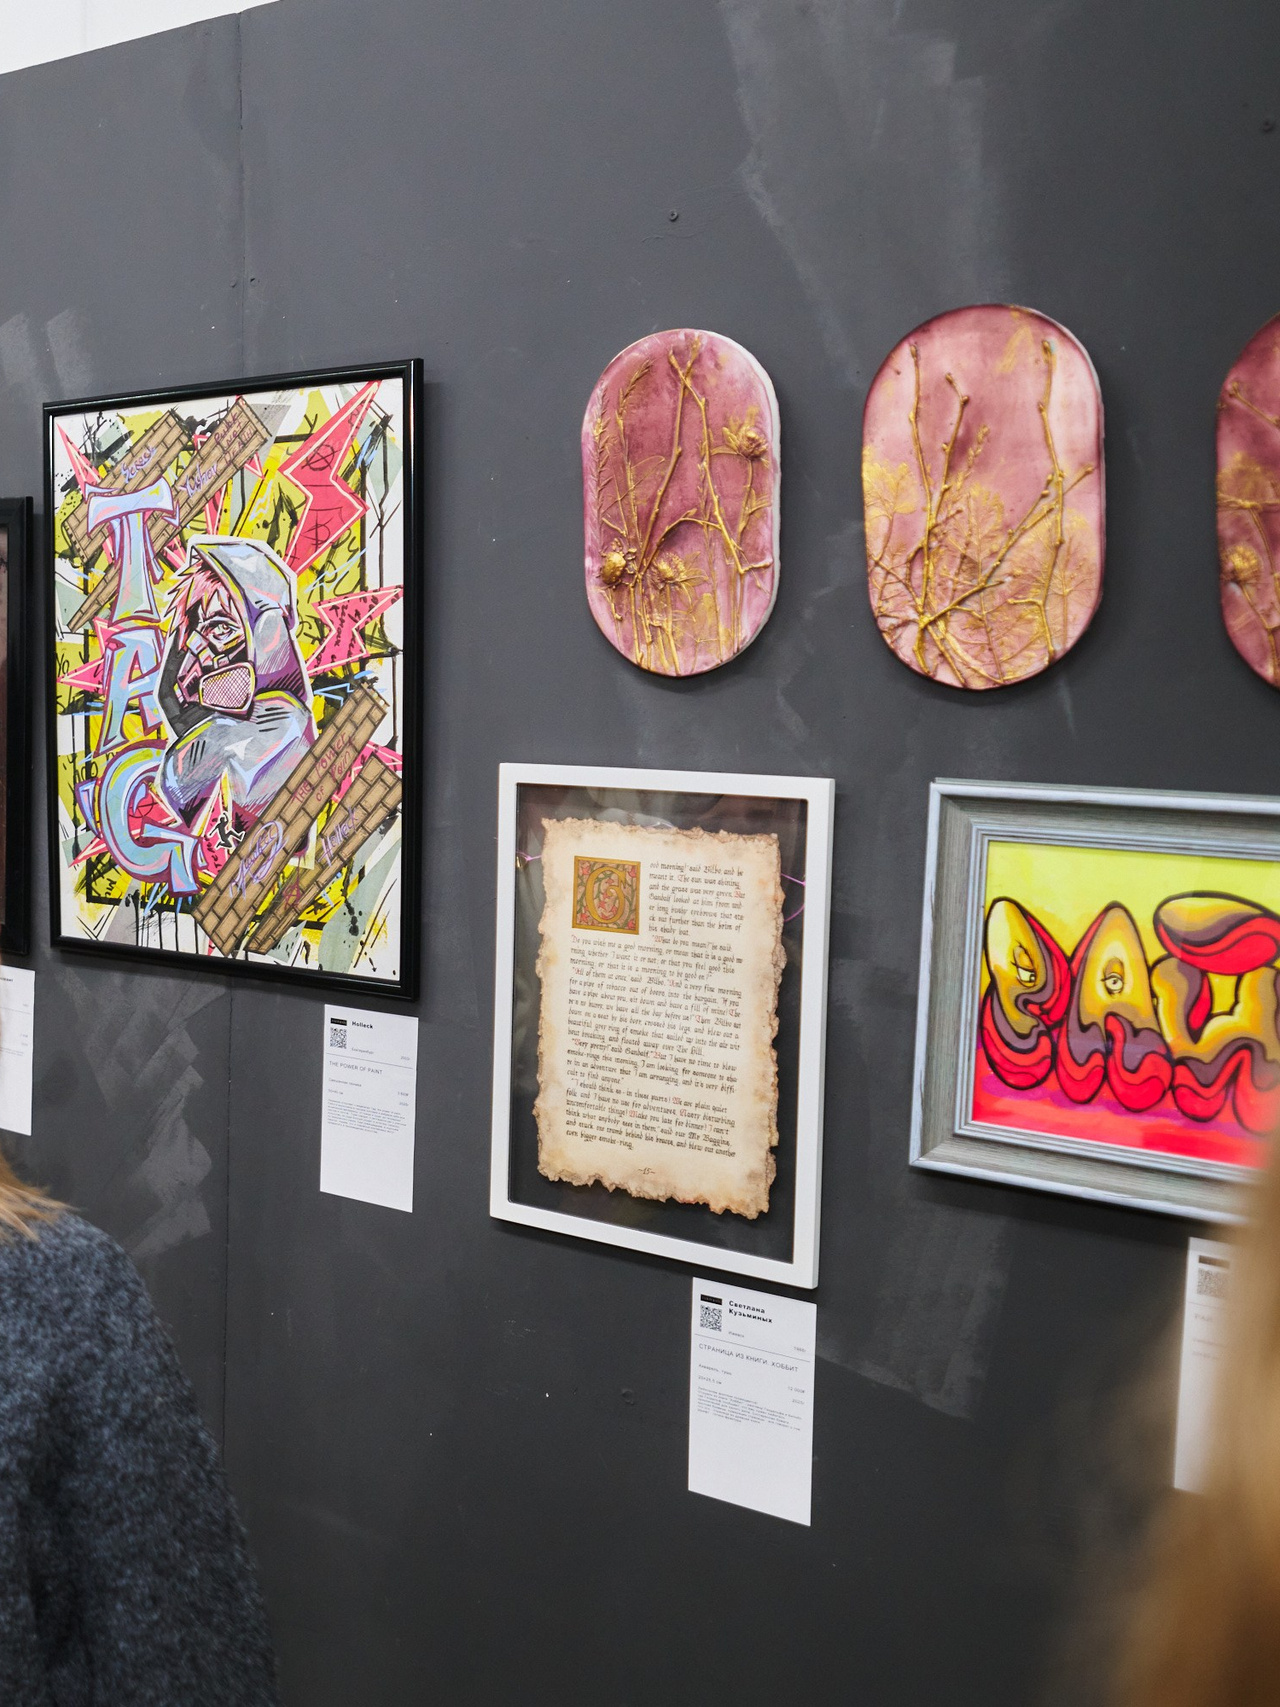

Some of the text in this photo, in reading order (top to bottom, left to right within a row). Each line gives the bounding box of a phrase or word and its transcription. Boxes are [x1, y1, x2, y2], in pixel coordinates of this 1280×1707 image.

[728, 1300, 766, 1314] Светлана
[729, 1308, 773, 1323] Кузьминых
[699, 1343, 734, 1356] СТРАНИЦА
